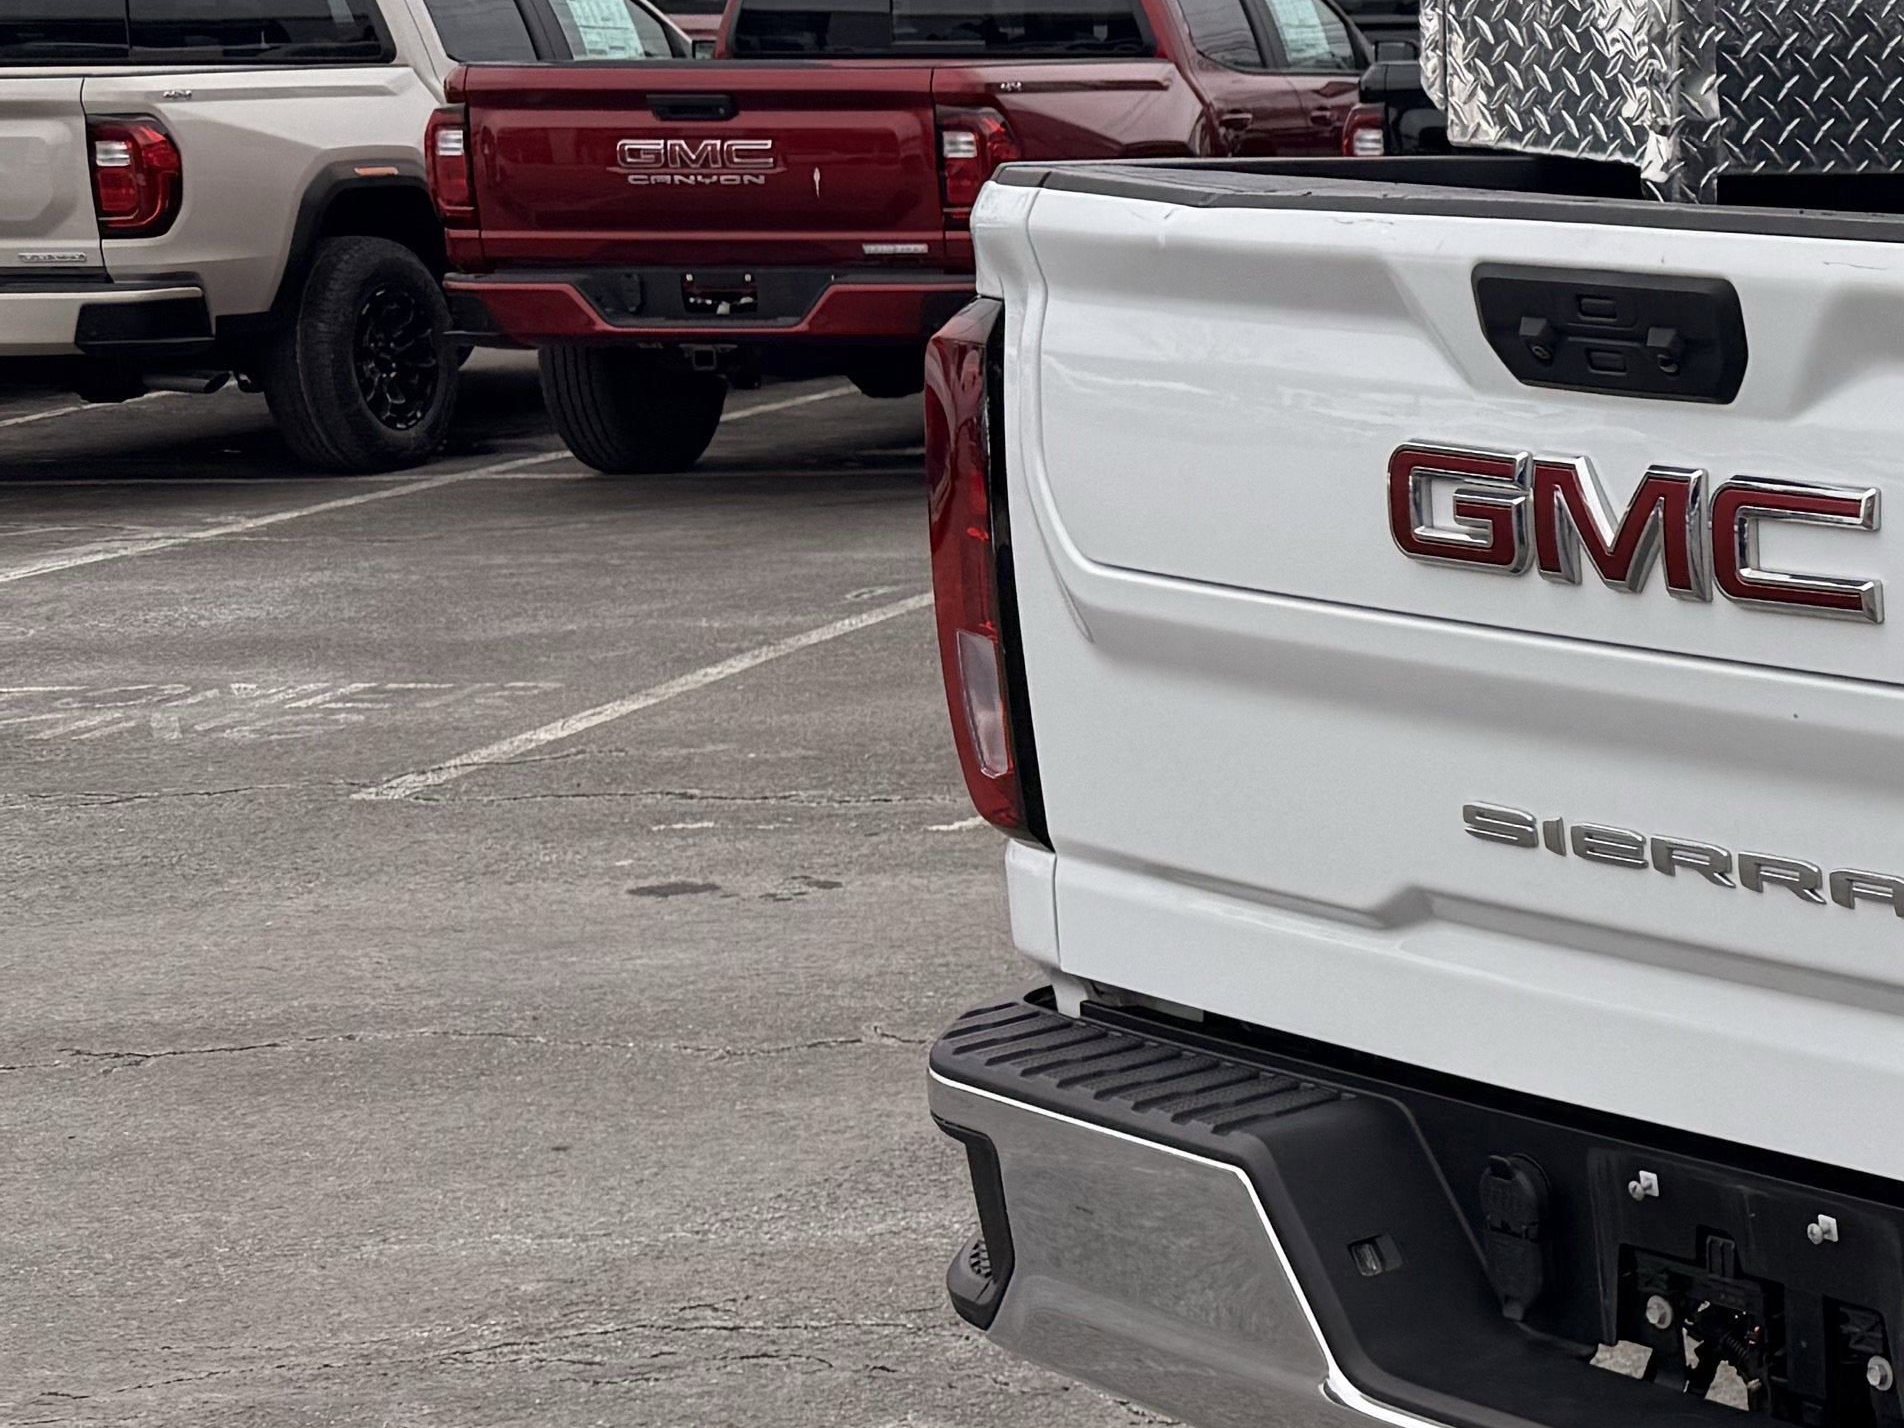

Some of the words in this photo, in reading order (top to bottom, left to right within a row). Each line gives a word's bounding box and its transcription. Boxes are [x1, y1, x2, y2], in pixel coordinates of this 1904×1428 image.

[616, 139, 774, 168] GMC
[627, 175, 766, 185] CANYON
[1387, 438, 1884, 624] GMC
